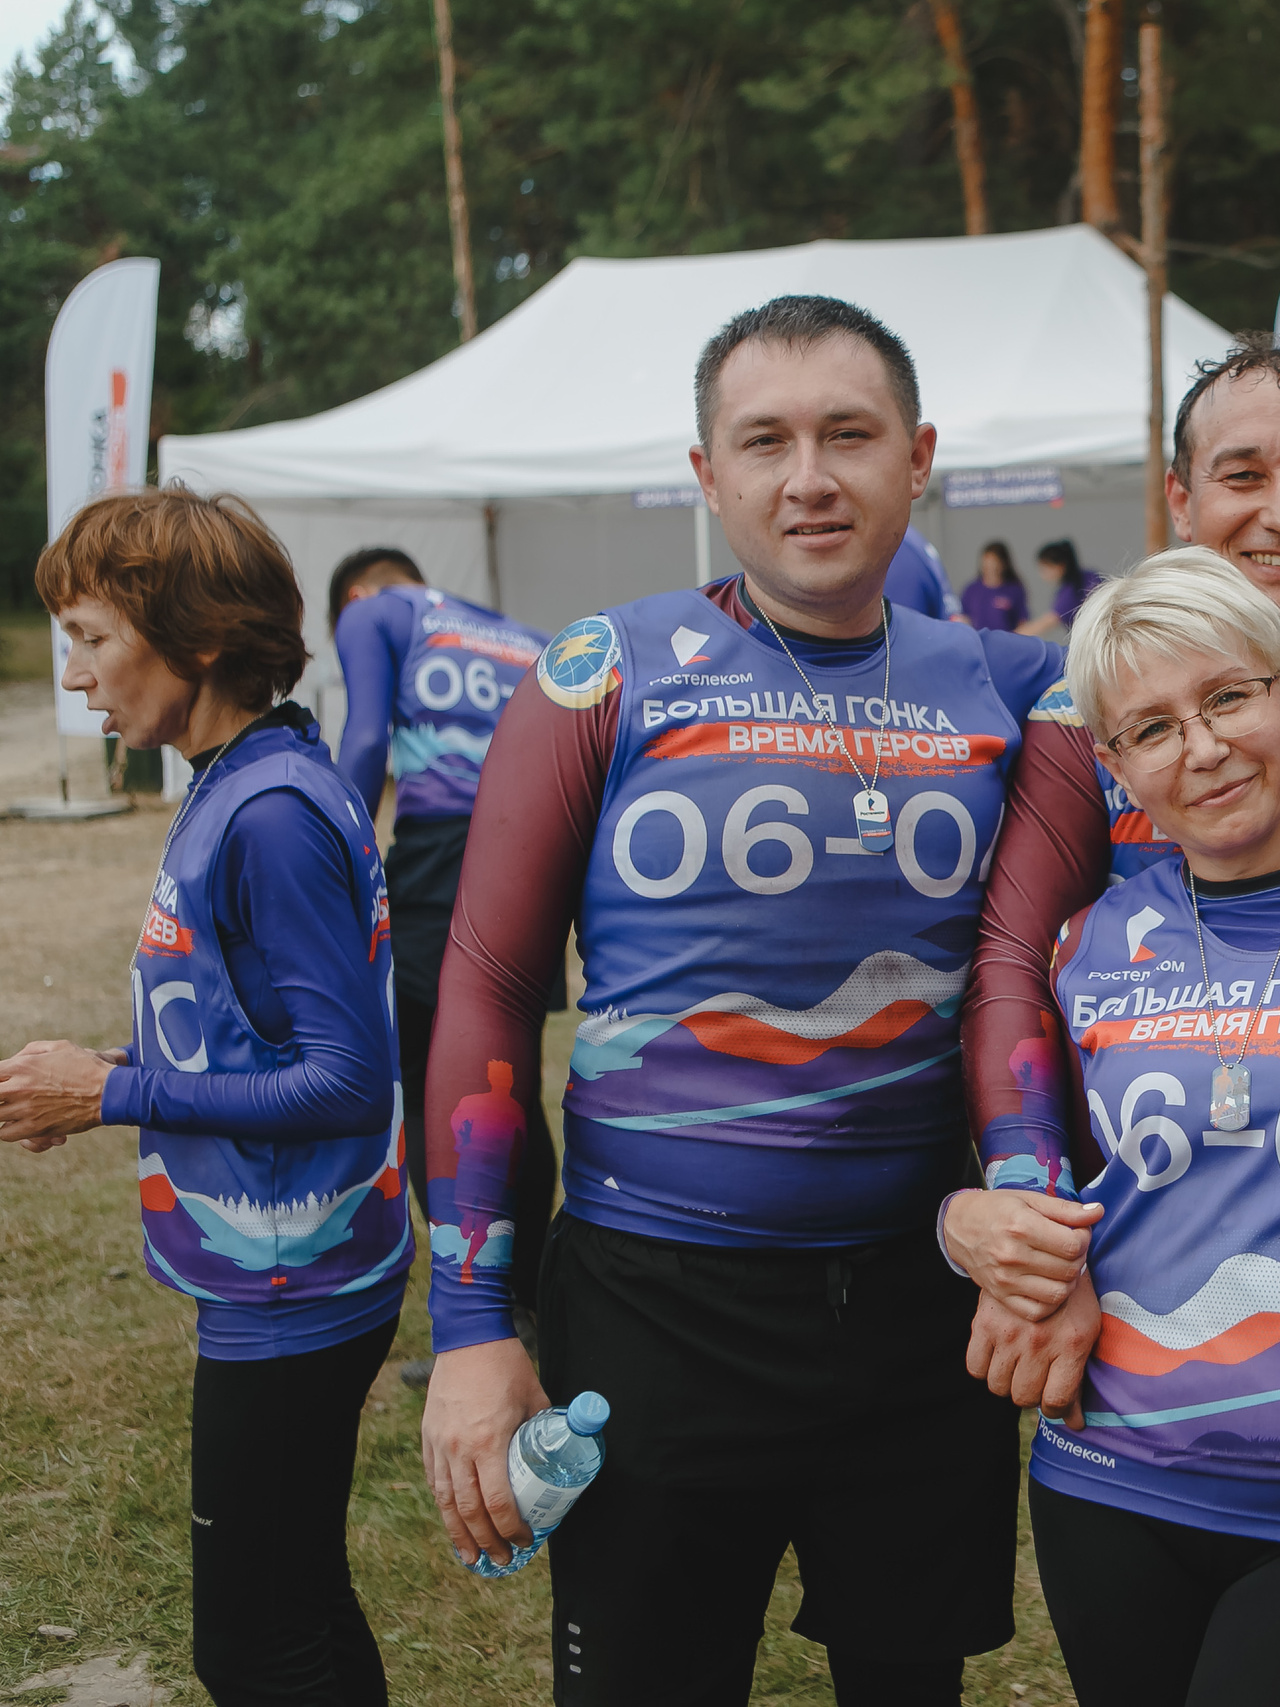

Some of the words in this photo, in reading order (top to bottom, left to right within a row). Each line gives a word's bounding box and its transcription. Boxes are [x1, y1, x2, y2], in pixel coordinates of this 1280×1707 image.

[643, 691, 835, 729] БОЛЬШАЯ
[846, 695, 959, 735] ГОНКА
[728, 725, 847, 755] ВРЕМЯ
[854, 731, 971, 762] ГЕРОЕВ
[612, 784, 1005, 899] 06-0
[1072, 980, 1254, 1028] БОЛЬШАЯ
[1128, 1012, 1248, 1042] ВРЕМЯ
[1039, 1417, 1116, 1469] Ростелеком
